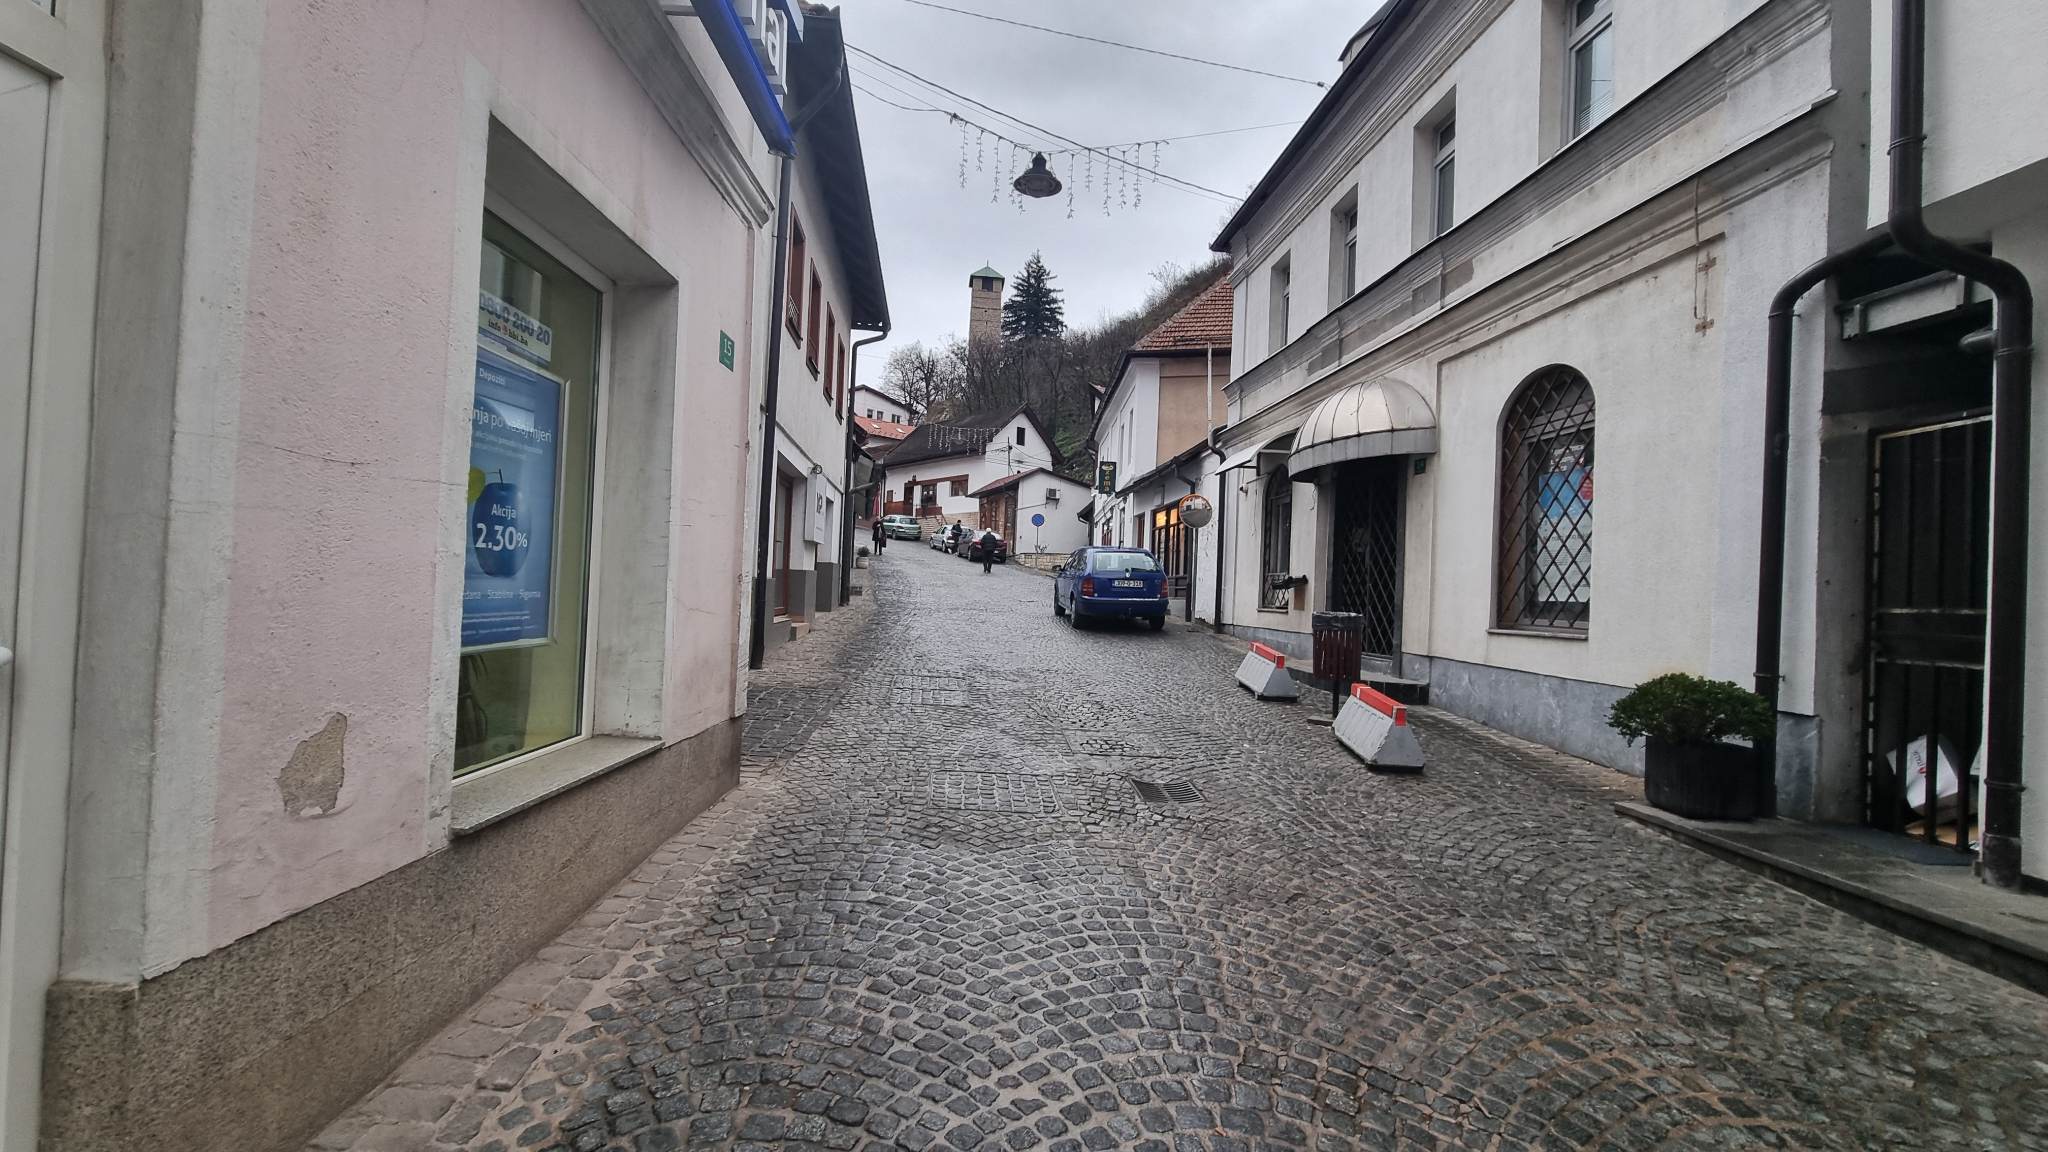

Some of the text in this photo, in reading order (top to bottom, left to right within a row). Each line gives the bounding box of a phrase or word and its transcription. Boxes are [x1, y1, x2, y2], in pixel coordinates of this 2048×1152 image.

[512, 310, 536, 337] 200
[536, 325, 551, 346] 20
[724, 338, 732, 357] 15
[491, 414, 504, 430] po
[491, 503, 517, 520] Akcija
[475, 522, 528, 552] 2.30%
